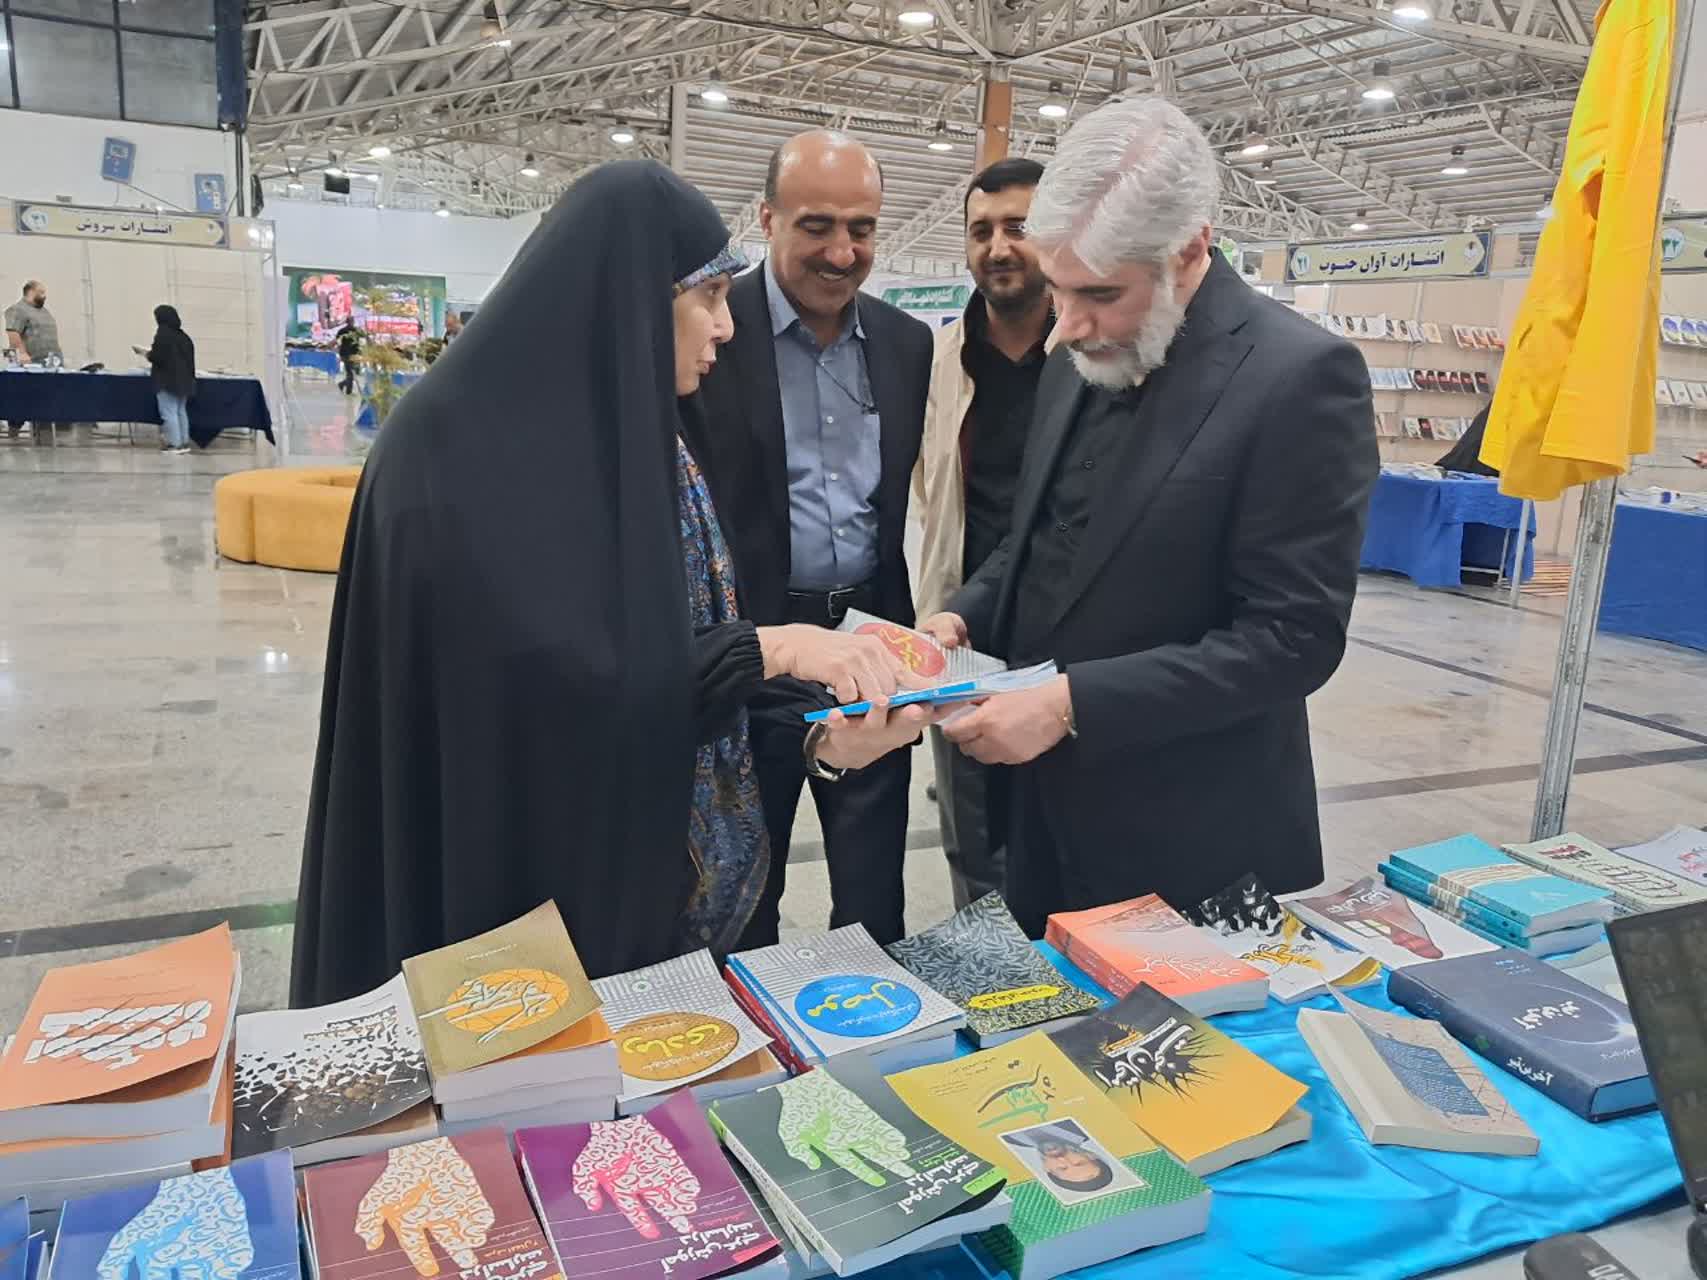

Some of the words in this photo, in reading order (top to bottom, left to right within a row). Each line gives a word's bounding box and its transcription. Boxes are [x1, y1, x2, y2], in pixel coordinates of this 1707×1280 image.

[76, 219, 116, 233] سروش
[122, 219, 172, 236] انتشارات
[1390, 250, 1445, 271] انتشارات
[905, 1173, 924, 1187] در
[922, 1154, 968, 1182] اسارت
[897, 1178, 949, 1214] آموزش
[948, 1161, 979, 1183] عربی
[679, 1231, 700, 1245] در
[699, 1222, 753, 1244] اسارت
[481, 1248, 543, 1279] اسارت
[660, 1242, 722, 1274] آموزش
[723, 1232, 760, 1251] عربی
